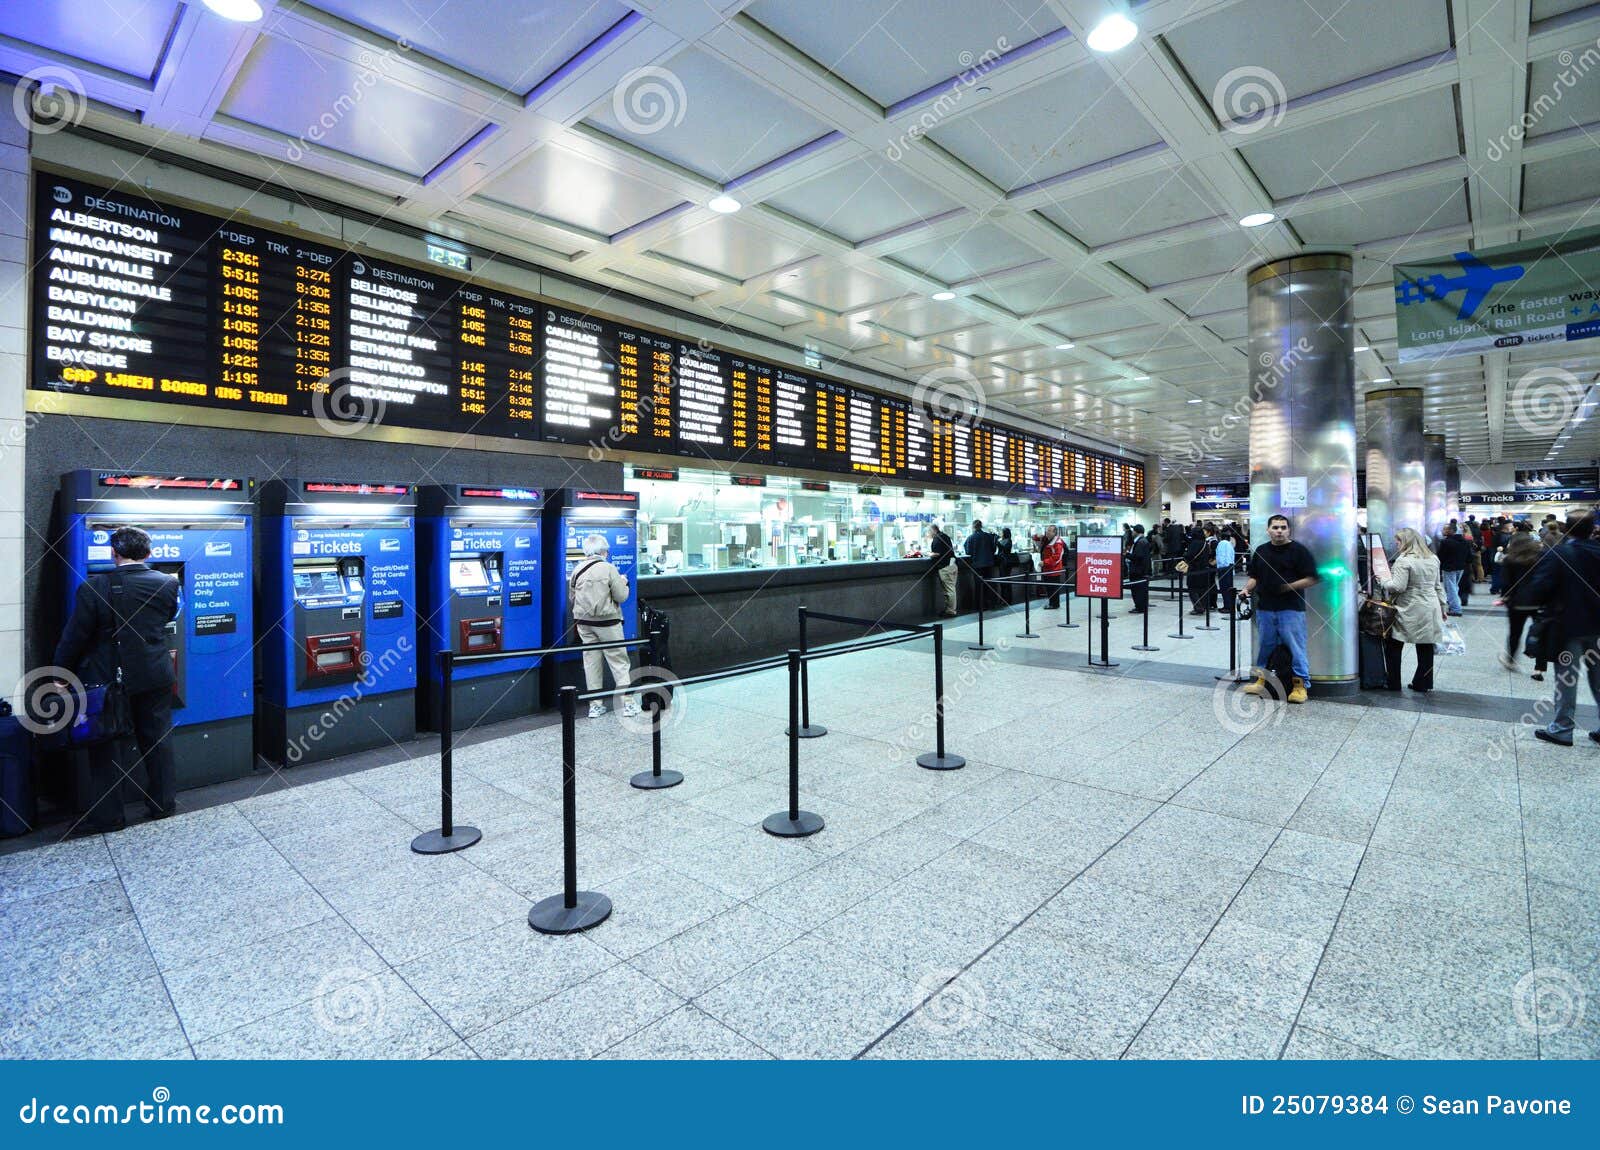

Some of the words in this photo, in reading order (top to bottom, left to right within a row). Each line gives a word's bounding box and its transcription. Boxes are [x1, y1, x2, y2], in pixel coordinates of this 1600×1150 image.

[51, 208, 158, 244] ALBERTSON
[84, 195, 181, 229] DESTINATION
[266, 241, 289, 255] TRK
[50, 228, 173, 265] AMAGANSETT
[50, 247, 154, 280] AMITYVILLE
[49, 266, 172, 302] AUBURNDALE
[350, 278, 418, 304] BELLEROSE
[372, 267, 435, 291] DESTINATION
[489, 297, 505, 309] TRK
[48, 286, 137, 314] BABYLON
[350, 293, 413, 317] BELLMORE
[1488, 303, 1516, 315] The
[1519, 294, 1567, 310] faster
[1568, 289, 1600, 302] way
[48, 305, 132, 332] BALDWIN
[350, 309, 410, 331] BELLPORT
[560, 315, 603, 333] DESTINATION
[1411, 329, 1446, 342] Long
[1449, 320, 1490, 337] Island
[1495, 315, 1521, 329] Rail
[1526, 307, 1566, 323] Road
[47, 325, 86, 343] BAY
[88, 331, 153, 354] SHORE
[1527, 332, 1555, 343] ticket
[47, 345, 128, 369] BAYSIDE
[350, 354, 426, 378] BRENTWOOD
[62, 367, 98, 383] GAP
[249, 390, 288, 406] TRAIN
[1481, 494, 1514, 503] Tracks
[311, 540, 362, 554] Tickets
[463, 537, 502, 549] Tickets
[372, 564, 409, 572] Credit/Debit
[1085, 556, 1113, 566] Please
[1088, 566, 1110, 575] Form
[194, 572, 244, 581] Credit/Debit
[194, 580, 213, 588] ATM
[215, 579, 239, 587] Cards
[1090, 575, 1108, 584] One
[1090, 584, 1108, 593] Line
[194, 588, 214, 597] Only
[194, 601, 207, 609] No
[208, 600, 230, 609] Cash
